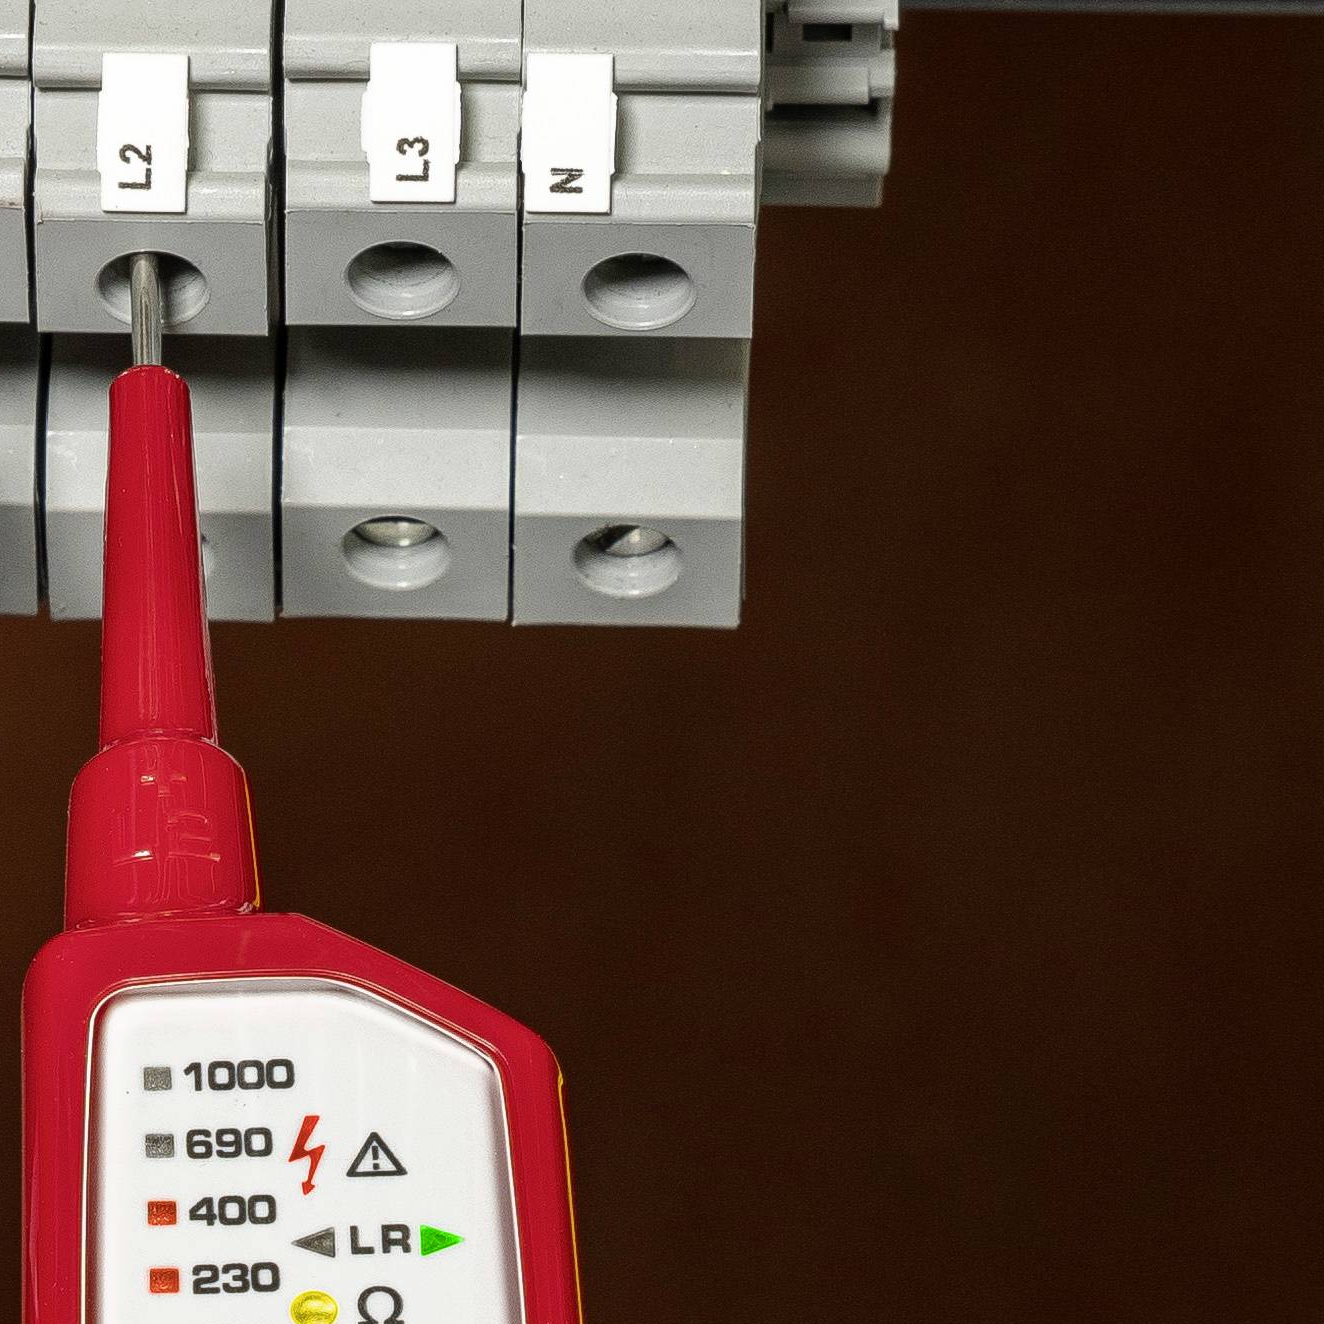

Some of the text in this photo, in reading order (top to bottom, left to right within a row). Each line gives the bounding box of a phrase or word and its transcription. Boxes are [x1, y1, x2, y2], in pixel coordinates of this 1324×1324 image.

[118, 143, 152, 191] L2
[395, 136, 430, 183] L3
[549, 167, 584, 195] N
[183, 1058, 295, 1092] 1000
[186, 1127, 274, 1160] 690
[188, 1194, 277, 1227] 400
[192, 1261, 281, 1295] 230
